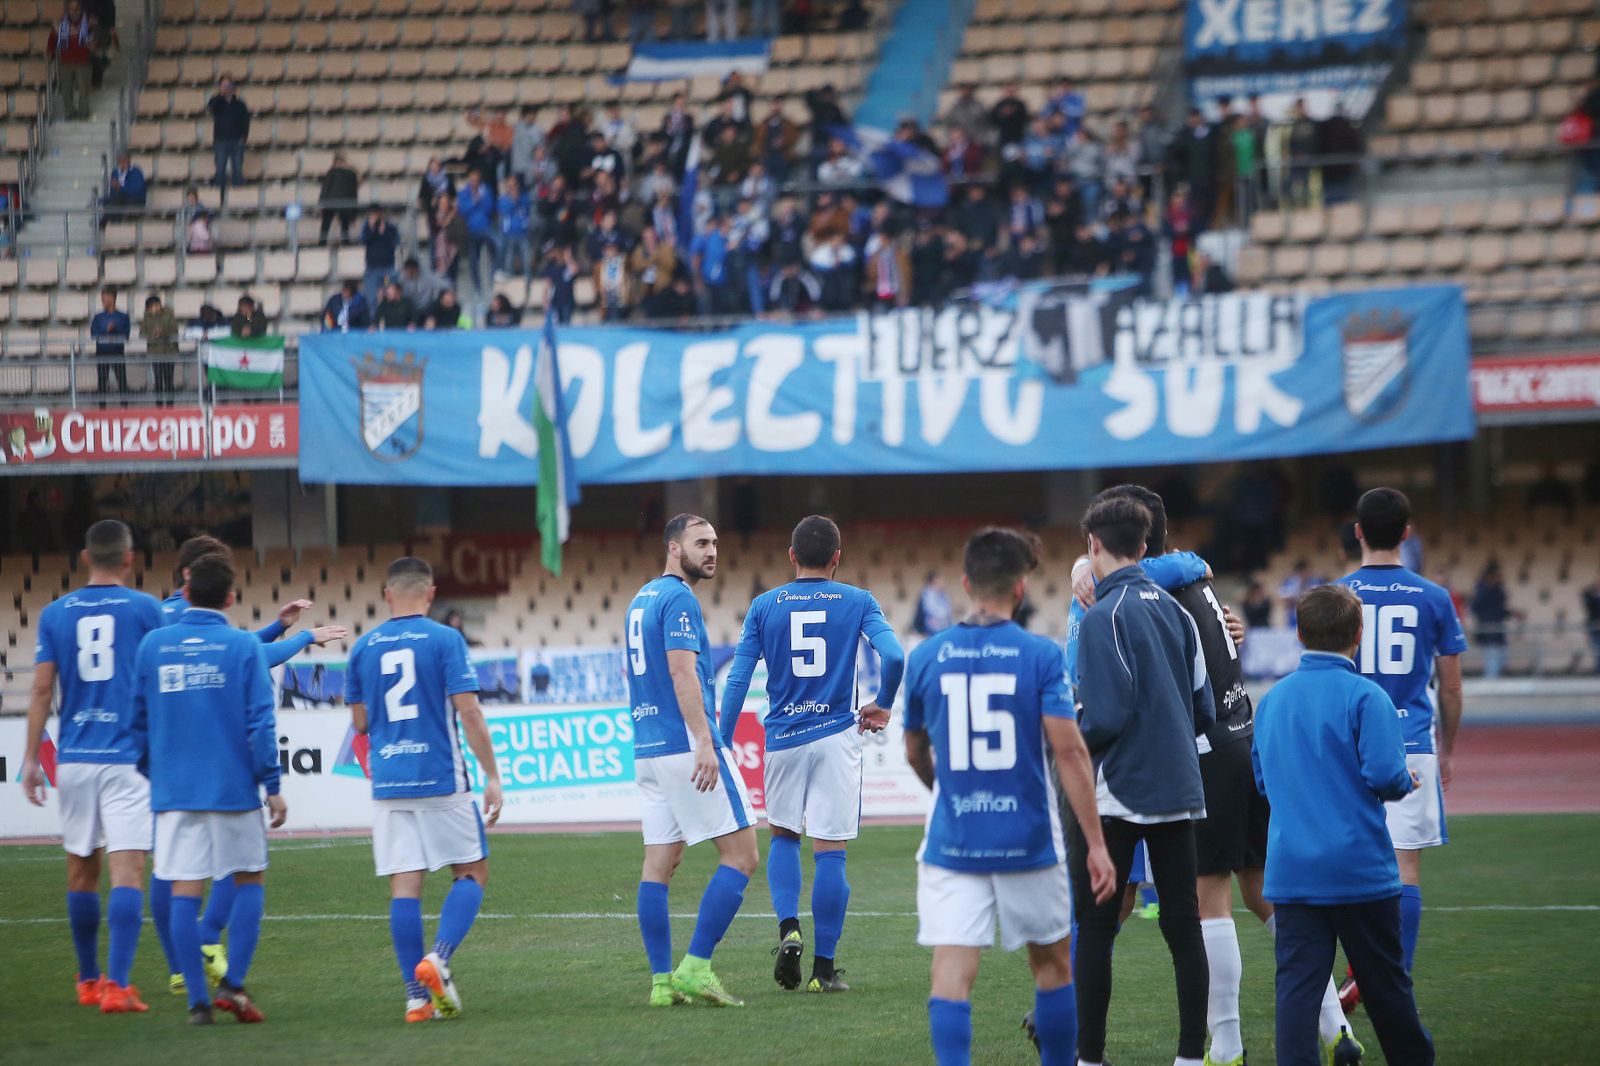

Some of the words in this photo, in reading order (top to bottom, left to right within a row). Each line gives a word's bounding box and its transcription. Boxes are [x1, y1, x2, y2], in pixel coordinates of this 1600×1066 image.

[60, 411, 257, 457] Cruzcampo
[77, 614, 115, 682] 8
[628, 608, 647, 676] 9
[790, 610, 827, 678] 5
[1360, 604, 1419, 675] 16
[380, 648, 419, 723] 2
[488, 711, 636, 754] CUENTOS
[940, 672, 1017, 771] 15
[498, 746, 624, 786] ECIALES
